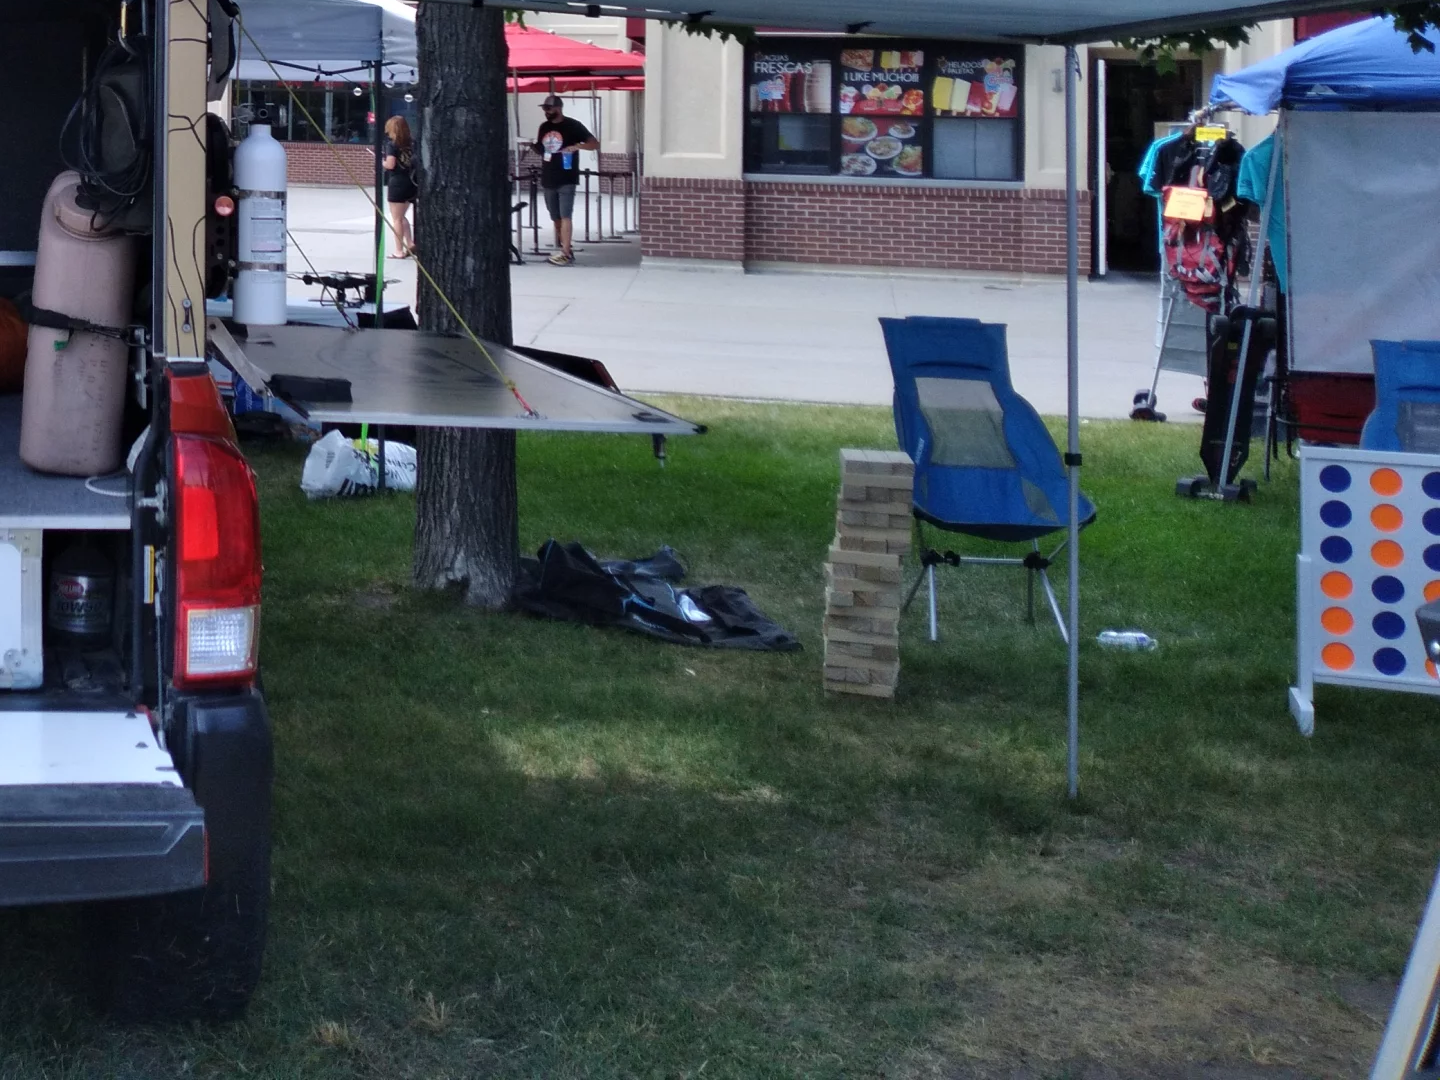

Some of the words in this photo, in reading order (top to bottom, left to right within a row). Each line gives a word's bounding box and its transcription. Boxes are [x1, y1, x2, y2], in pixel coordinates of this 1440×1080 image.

[763, 54, 789, 62] AGUAS
[753, 61, 813, 74] FRESCAS
[947, 60, 985, 69] HELADOS
[849, 72, 871, 82] LIKE
